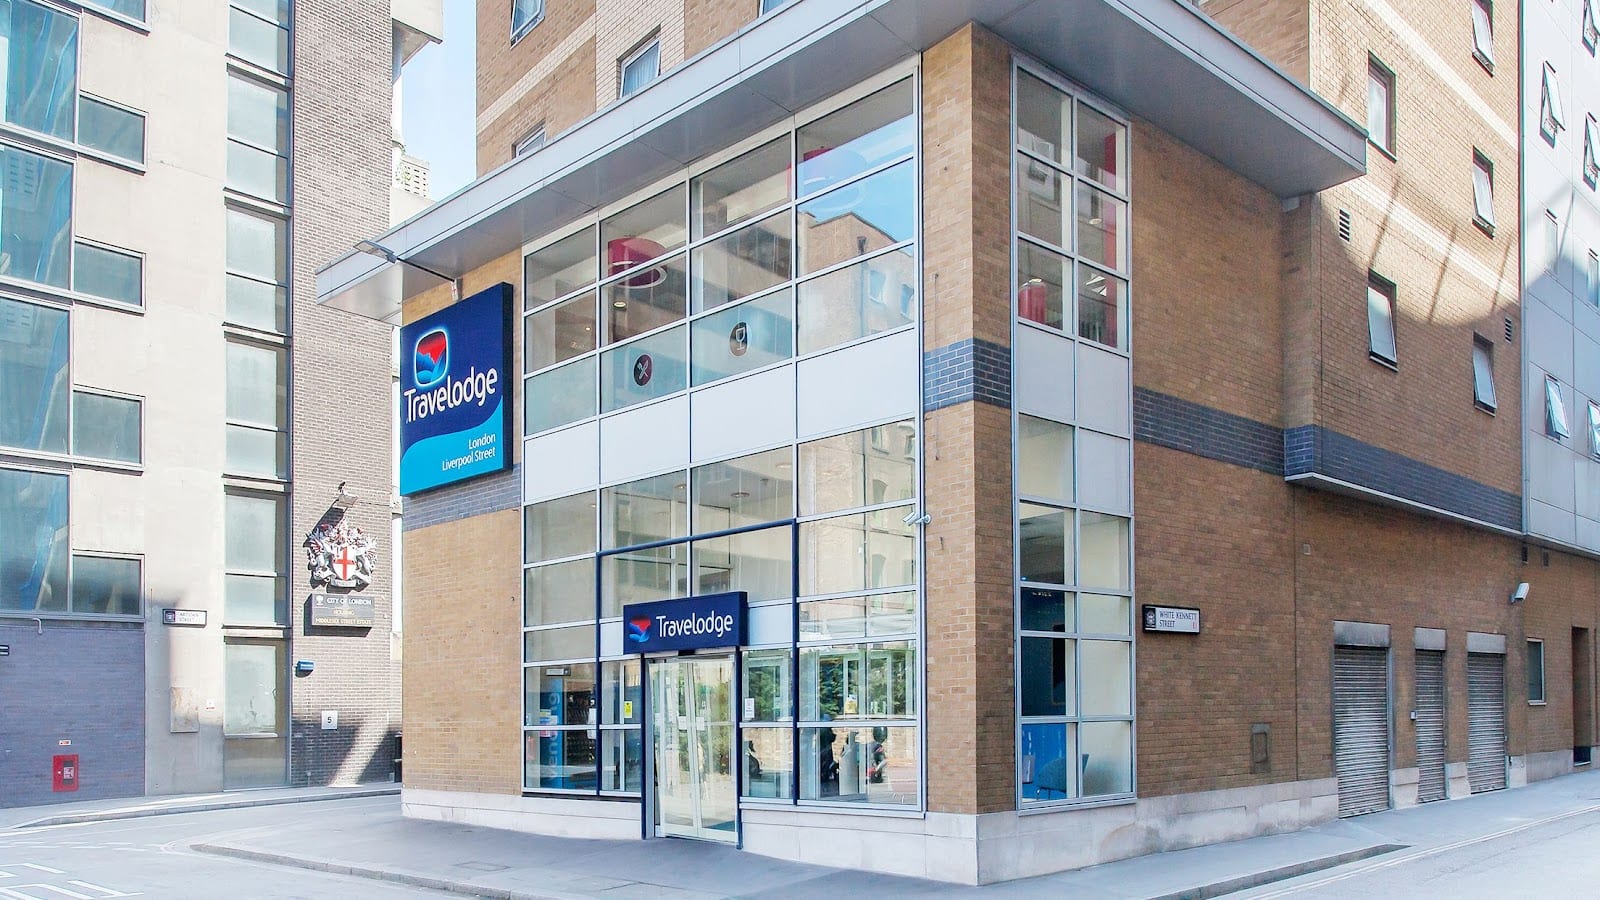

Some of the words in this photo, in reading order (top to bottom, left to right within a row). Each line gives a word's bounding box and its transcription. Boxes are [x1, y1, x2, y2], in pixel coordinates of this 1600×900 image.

[404, 366, 498, 424] Travelodge
[468, 432, 496, 450] London
[442, 450, 474, 471] Liverpool
[475, 446, 496, 462] Street
[655, 610, 733, 638] Travelodge
[1159, 610, 1174, 619] WHITE
[1175, 611, 1197, 620] KENNETT
[1159, 619, 1175, 628] STREET
[327, 716, 333, 724] 5
